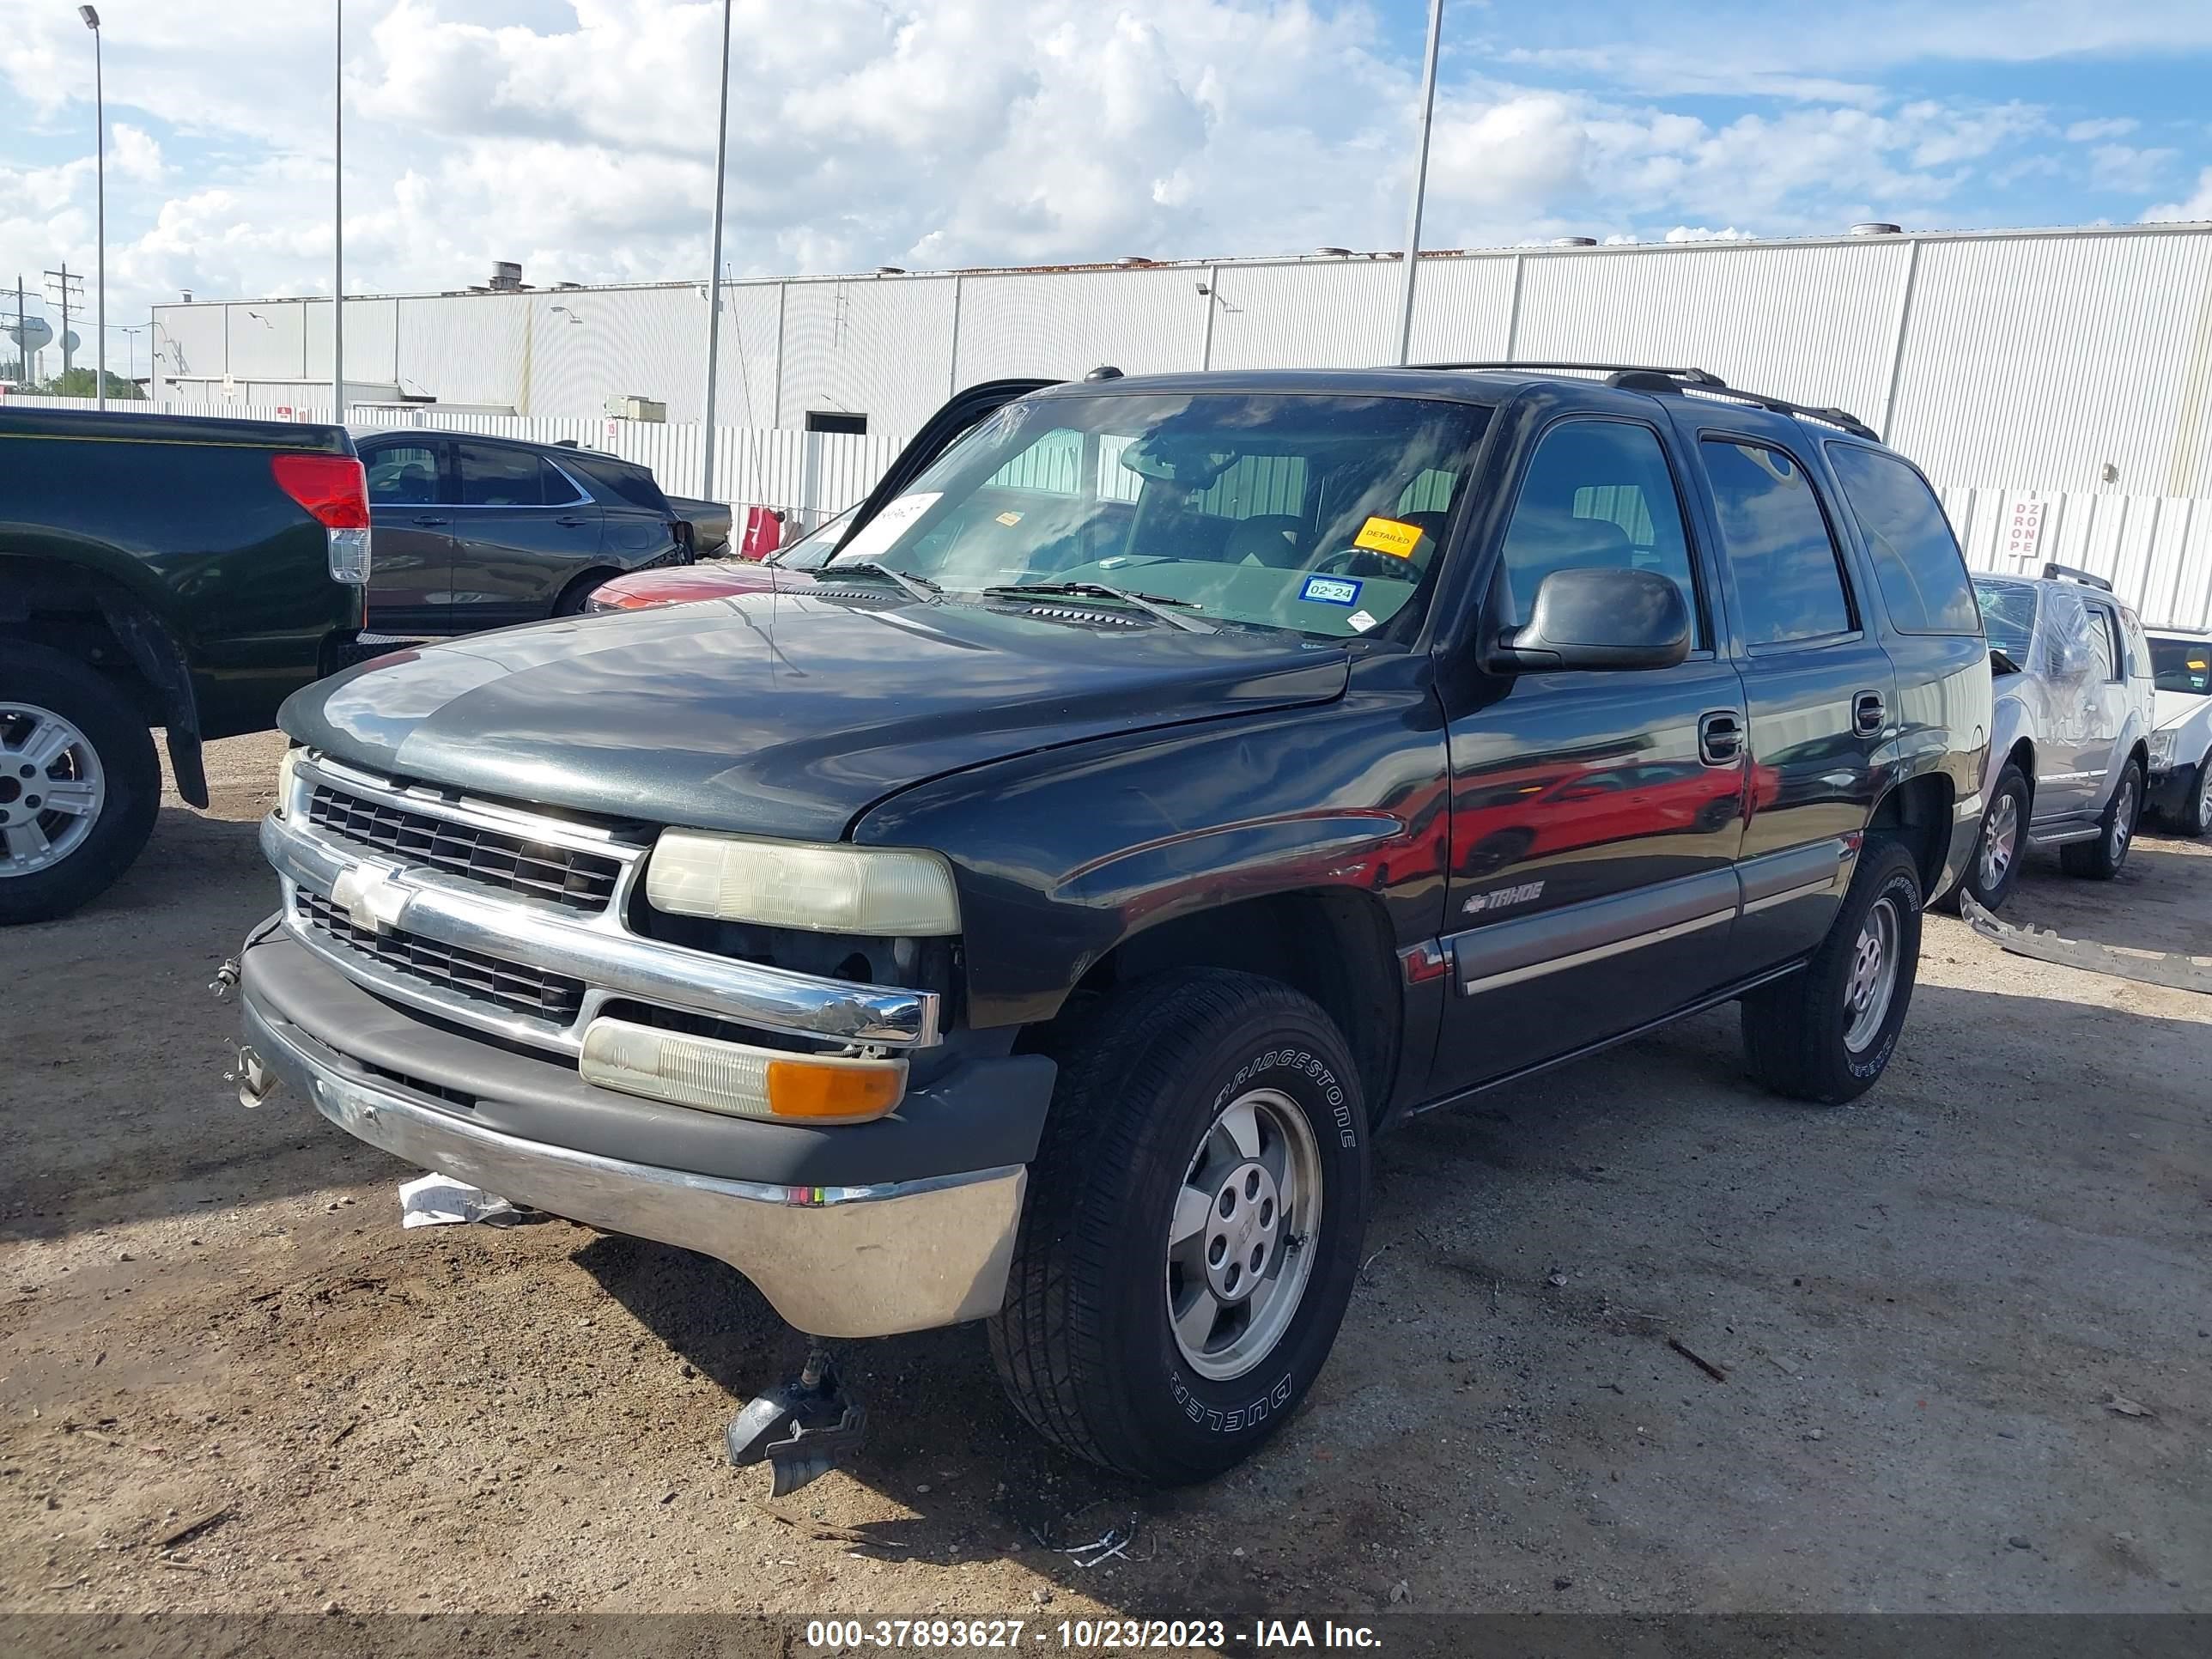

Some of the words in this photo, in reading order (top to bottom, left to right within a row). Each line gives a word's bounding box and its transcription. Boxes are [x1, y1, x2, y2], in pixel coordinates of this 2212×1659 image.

[1366, 529, 1410, 544] DETAILED
[2010, 503, 2027, 551] DROP
[2023, 504, 2039, 552] ZONE
[1310, 585, 1328, 595] 02
[1333, 587, 1352, 599] 24
[1488, 880, 1546, 909] TAHOE
[1212, 1048, 1357, 1148] BRIDGESTONE
[1170, 1370, 1292, 1432] DUELER
